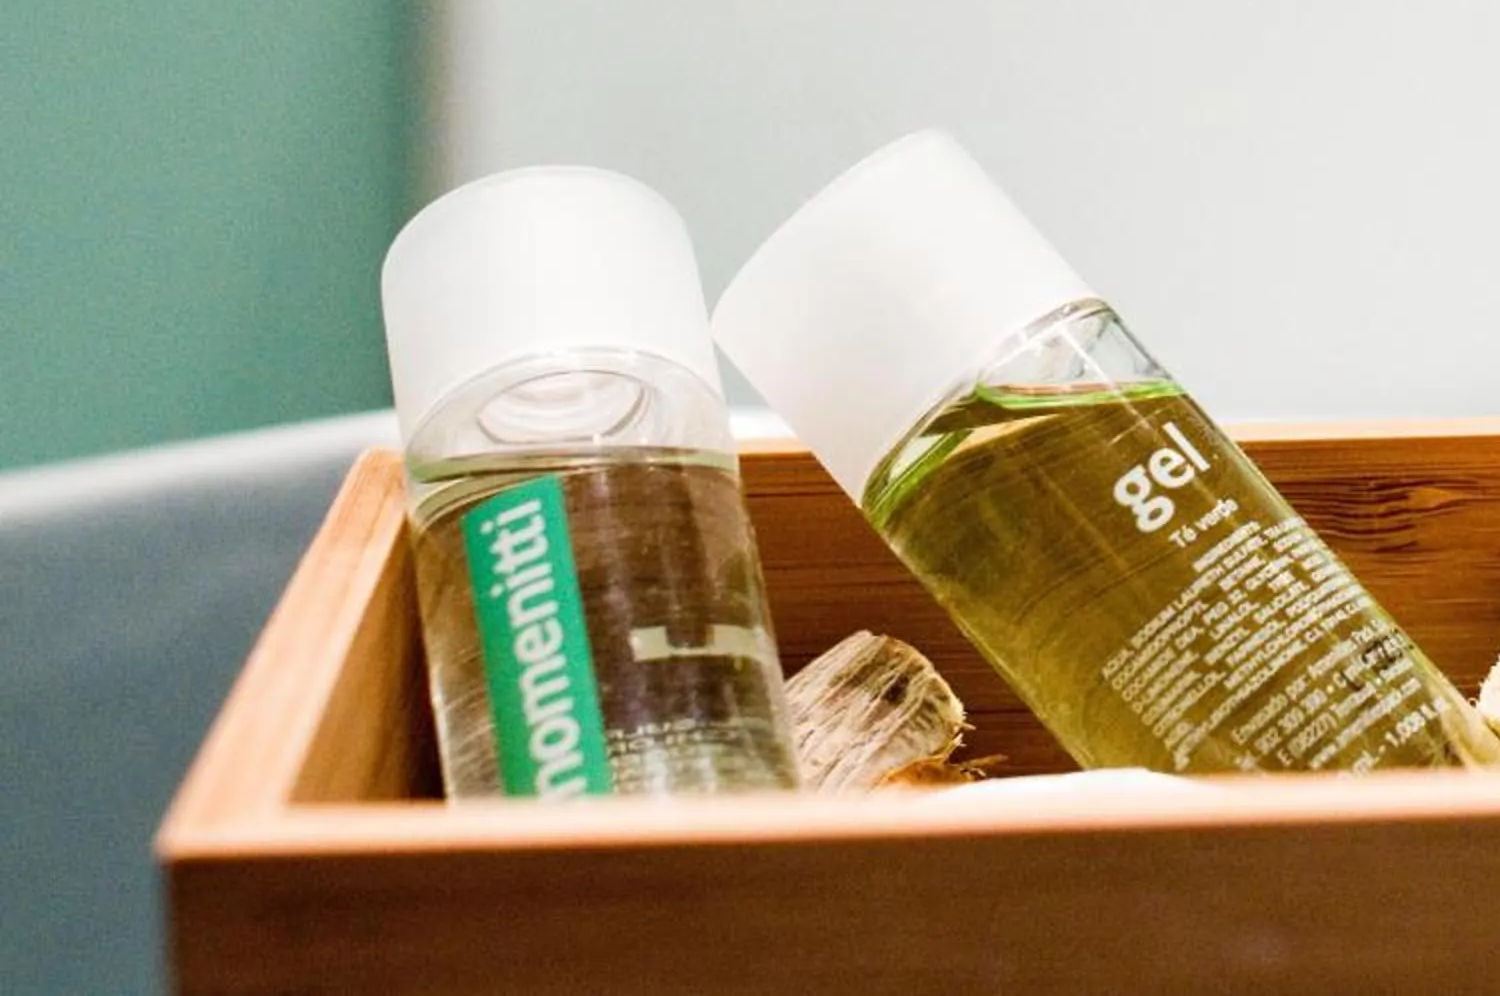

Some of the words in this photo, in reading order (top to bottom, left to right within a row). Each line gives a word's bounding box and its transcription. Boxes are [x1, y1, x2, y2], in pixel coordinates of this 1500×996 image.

[1113, 422, 1210, 533] gel
[1169, 525, 1197, 548] Té
[1195, 498, 1239, 531] verde
